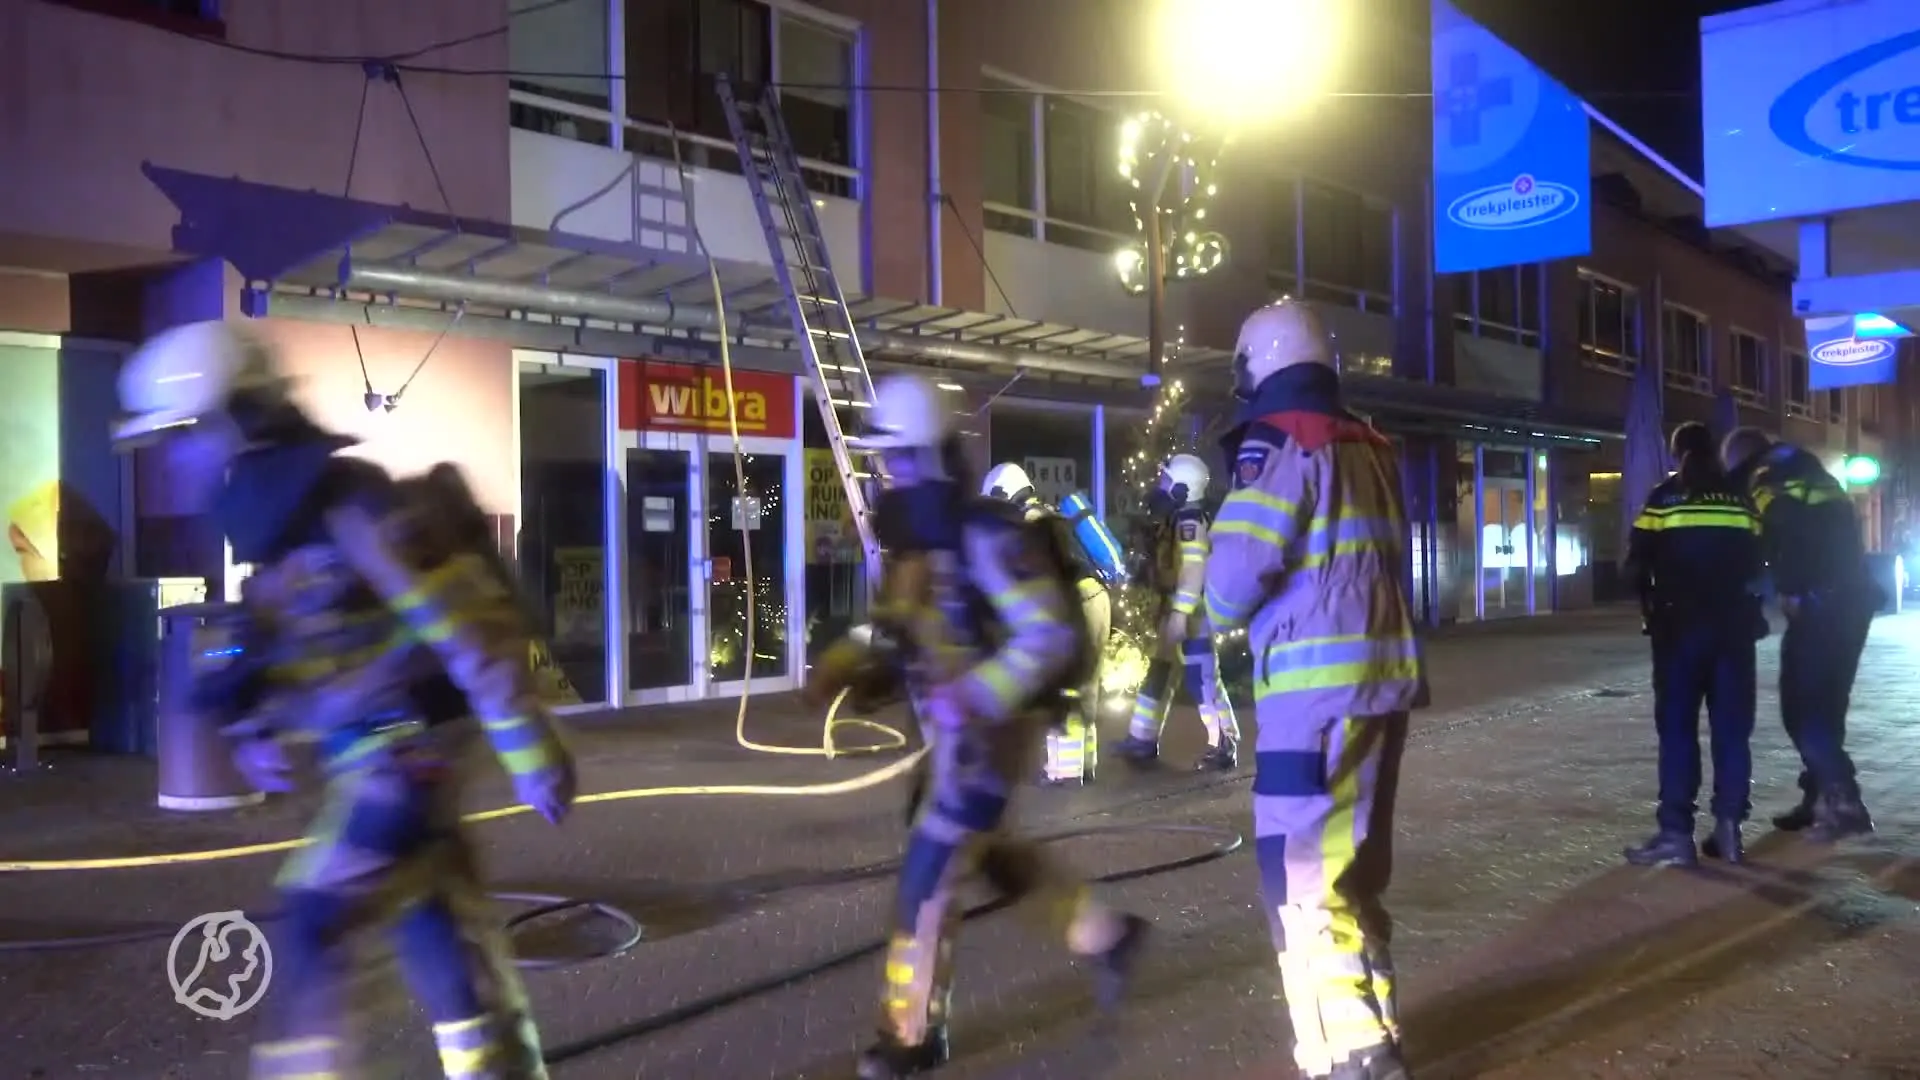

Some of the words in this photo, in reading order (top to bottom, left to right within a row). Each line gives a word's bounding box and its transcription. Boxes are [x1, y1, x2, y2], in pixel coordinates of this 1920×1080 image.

[1835, 86, 1920, 133] tre
[1465, 192, 1558, 217] trekpleister
[649, 376, 766, 420] wibra
[810, 466, 834, 483] OP
[810, 503, 841, 520] ING
